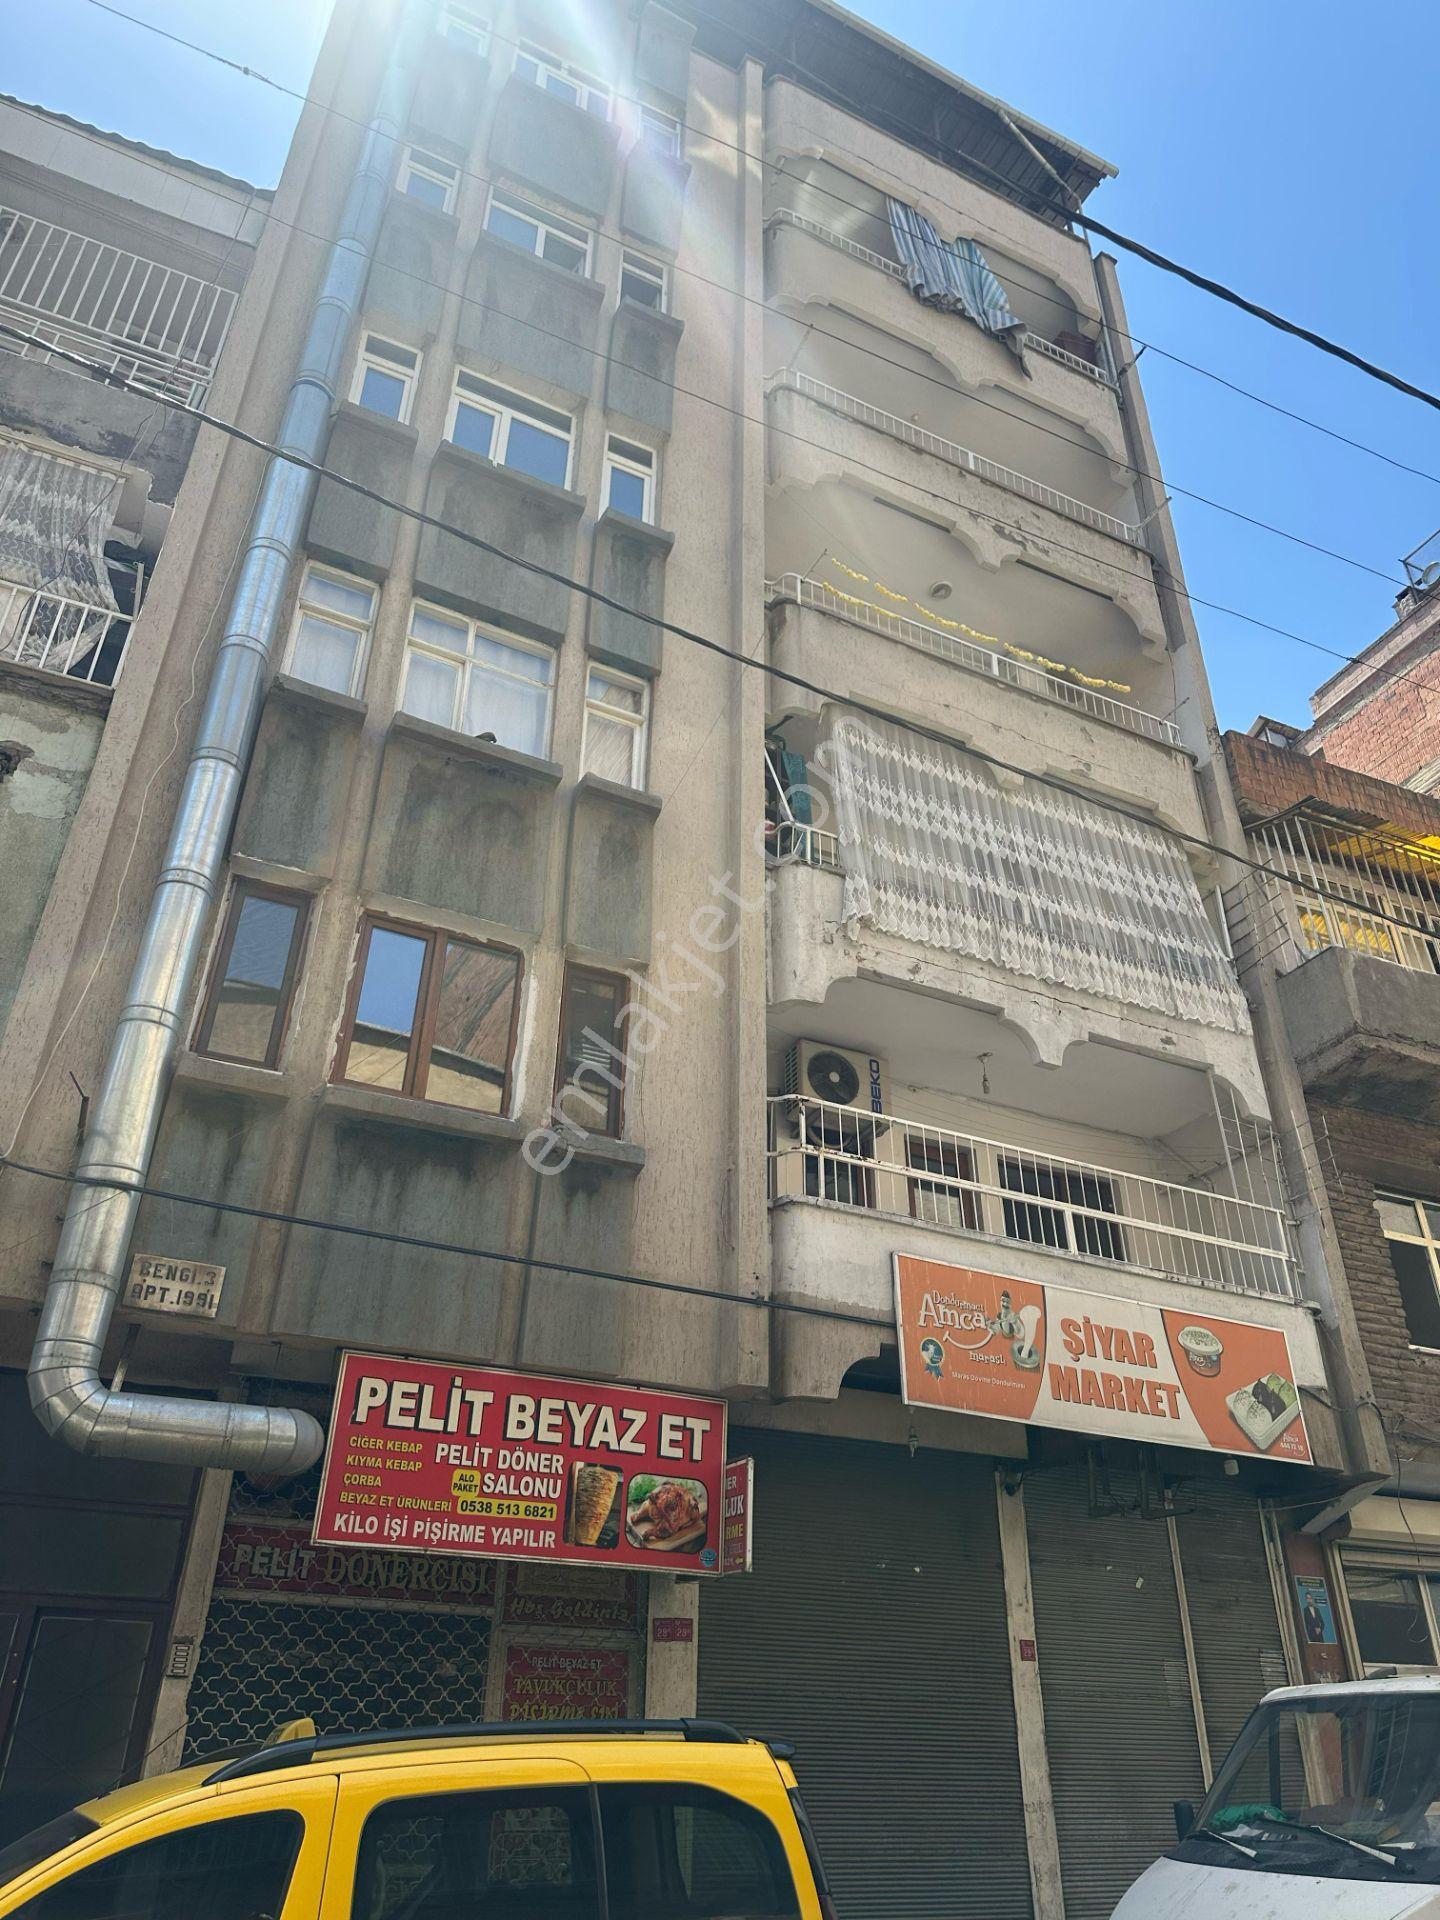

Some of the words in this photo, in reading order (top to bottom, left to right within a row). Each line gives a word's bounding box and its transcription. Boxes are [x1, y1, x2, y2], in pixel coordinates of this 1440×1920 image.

[869, 1058, 883, 1115] BEKO
[918, 1293, 987, 1330] Amca
[1060, 1315, 1158, 1369] ŞİYAR
[1048, 1363, 1180, 1420] MARKET
[352, 1375, 495, 1437] PELİT
[505, 1394, 648, 1455] BEYAZ
[659, 1413, 711, 1462] ET
[386, 1442, 423, 1454] KEBAP
[435, 1442, 493, 1468] PELİT
[498, 1446, 564, 1475] DÖNER
[346, 1454, 382, 1468] KIYMA
[385, 1458, 423, 1472] KEBAP
[343, 1472, 382, 1488] ÇORBA
[453, 1482, 479, 1494] PAKET
[458, 1473, 475, 1483] ALO
[482, 1472, 562, 1499] SALONU
[339, 1491, 377, 1506] BEYAZ
[379, 1495, 394, 1508] ET
[460, 1499, 493, 1514] 0538
[496, 1502, 520, 1516] 513
[524, 1506, 555, 1519] 6821
[725, 1494, 744, 1518] LUK
[334, 1510, 379, 1535] KİLO
[384, 1514, 409, 1542] İŞİ
[412, 1517, 487, 1545] PİŞİRME
[490, 1526, 556, 1549] YAPILIR
[725, 1523, 744, 1540] RME
